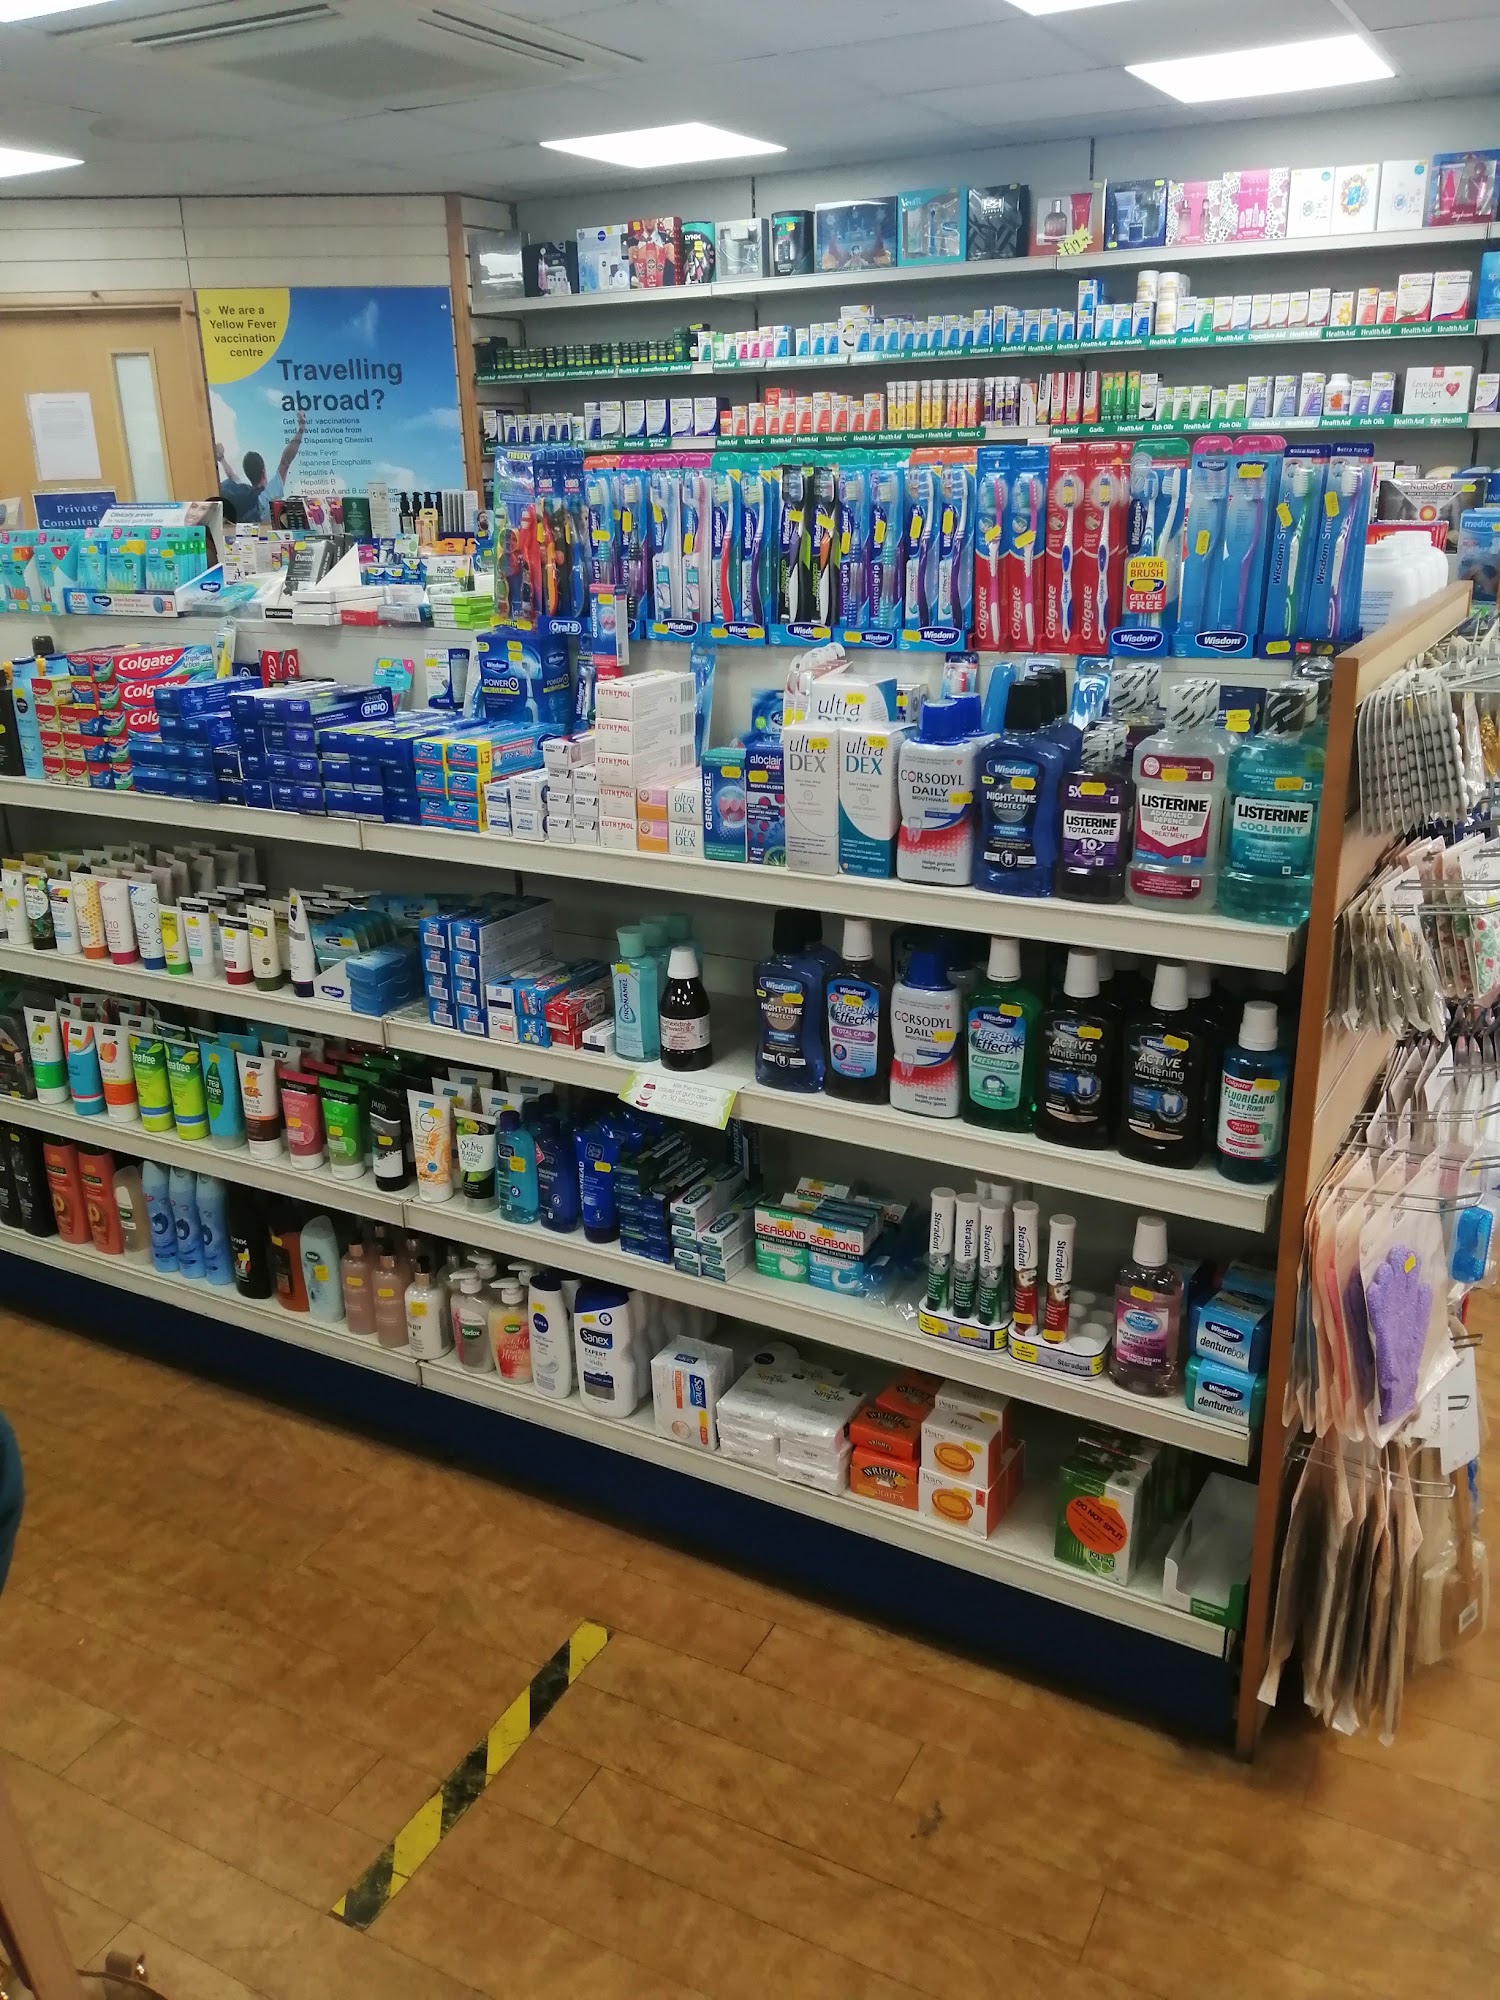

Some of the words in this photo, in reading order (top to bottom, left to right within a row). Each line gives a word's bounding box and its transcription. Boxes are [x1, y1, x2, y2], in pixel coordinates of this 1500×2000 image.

[218, 306, 236, 315] We
[239, 307, 255, 315] are
[210, 319, 244, 329] Yellow
[248, 319, 277, 329] Fever
[214, 334, 275, 343] vaccination
[230, 348, 263, 357] centre
[276, 358, 402, 385] Travelling
[282, 389, 385, 411] abroad?
[1430, 417, 1441, 425] Eye
[57, 505, 98, 513] Private
[42, 518, 101, 528] Consultati
[1132, 501, 1142, 545] Wisdom
[1131, 569, 1164, 578] BRUSH
[1130, 601, 1162, 610] FREE
[977, 586, 987, 640] Colgate
[1011, 586, 1021, 640] Colgate
[1046, 585, 1057, 640] Colgate
[1081, 585, 1093, 641] Colgate
[667, 621, 694, 630] Wisdom
[924, 631, 955, 640] Wisdom
[1121, 633, 1158, 643] Wisdom
[1204, 636, 1242, 646] Wisdom
[118, 656, 174, 672] Colgate
[484, 679, 508, 687] POWER
[597, 688, 631, 699] EUTHYMOL
[129, 710, 160, 727] Colg
[597, 723, 631, 734] EUTHYMOL
[597, 756, 630, 767] EUTHYMOL
[750, 753, 782, 766] aloclair
[790, 754, 826, 773] DEX
[846, 755, 882, 775] DEX
[994, 764, 1031, 776] Wisdom
[901, 770, 965, 786] CORSODYL
[600, 787, 633, 799] EUTHYMOL
[912, 786, 948, 796] DAILY
[987, 791, 1036, 803] NIGHT-TIME
[674, 793, 695, 804] ultra
[705, 773, 713, 831] GENGIGEL
[1141, 795, 1209, 813] LISTERINE
[674, 803, 695, 814] DEX
[994, 802, 1026, 810] PROTECT
[1150, 811, 1193, 820] ADVANCED
[1238, 804, 1310, 823] LISTERINE
[601, 820, 634, 831] EUTHYMOL
[1066, 816, 1118, 829] LISTERINE
[1153, 816, 1189, 826] DEFENCE
[675, 826, 696, 837] ultra
[1068, 827, 1090, 835] TOTAL
[1091, 828, 1114, 836] CARE
[1151, 830, 1189, 839] TREATMENT
[1240, 821, 1270, 833] COOL
[1272, 825, 1303, 835] MINT
[675, 836, 696, 848] DEX
[761, 1002, 802, 1015] NIGHT-TIME
[767, 1012, 795, 1020] PROTECT
[835, 1012, 865, 1025] Effect
[894, 1010, 952, 1028] CORSODYL
[983, 1013, 1012, 1023] Wisdom
[836, 1028, 852, 1036] TOTAL
[977, 1028, 1010, 1043] Fresh
[1052, 1037, 1094, 1051] ACTIVE
[1049, 1047, 1097, 1063] Whitening
[1138, 1054, 1182, 1068] ACTIVE
[973, 1056, 1017, 1069] FRESHMINT
[1135, 1061, 1185, 1081] Whitening
[1225, 1078, 1250, 1089] Colgate
[933, 1211, 943, 1251] Steradent
[810, 1234, 861, 1253] SEABOND
[965, 1218, 974, 1258] Steradent
[983, 1223, 993, 1264] Steradent
[1018, 1225, 1026, 1267] Steradent
[1055, 1239, 1066, 1282] Steradent
[582, 1330, 609, 1346] Sanex
[1208, 1325, 1240, 1341] Wisdom
[1200, 1336, 1246, 1360] denturebox
[1207, 1384, 1240, 1399] Wisdom
[1197, 1396, 1246, 1417] denturebox
[923, 1473, 943, 1485] Pears
[1076, 1500, 1087, 1510] DO
[1088, 1510, 1103, 1523] NOT
[1103, 1522, 1124, 1540] SPLIT
